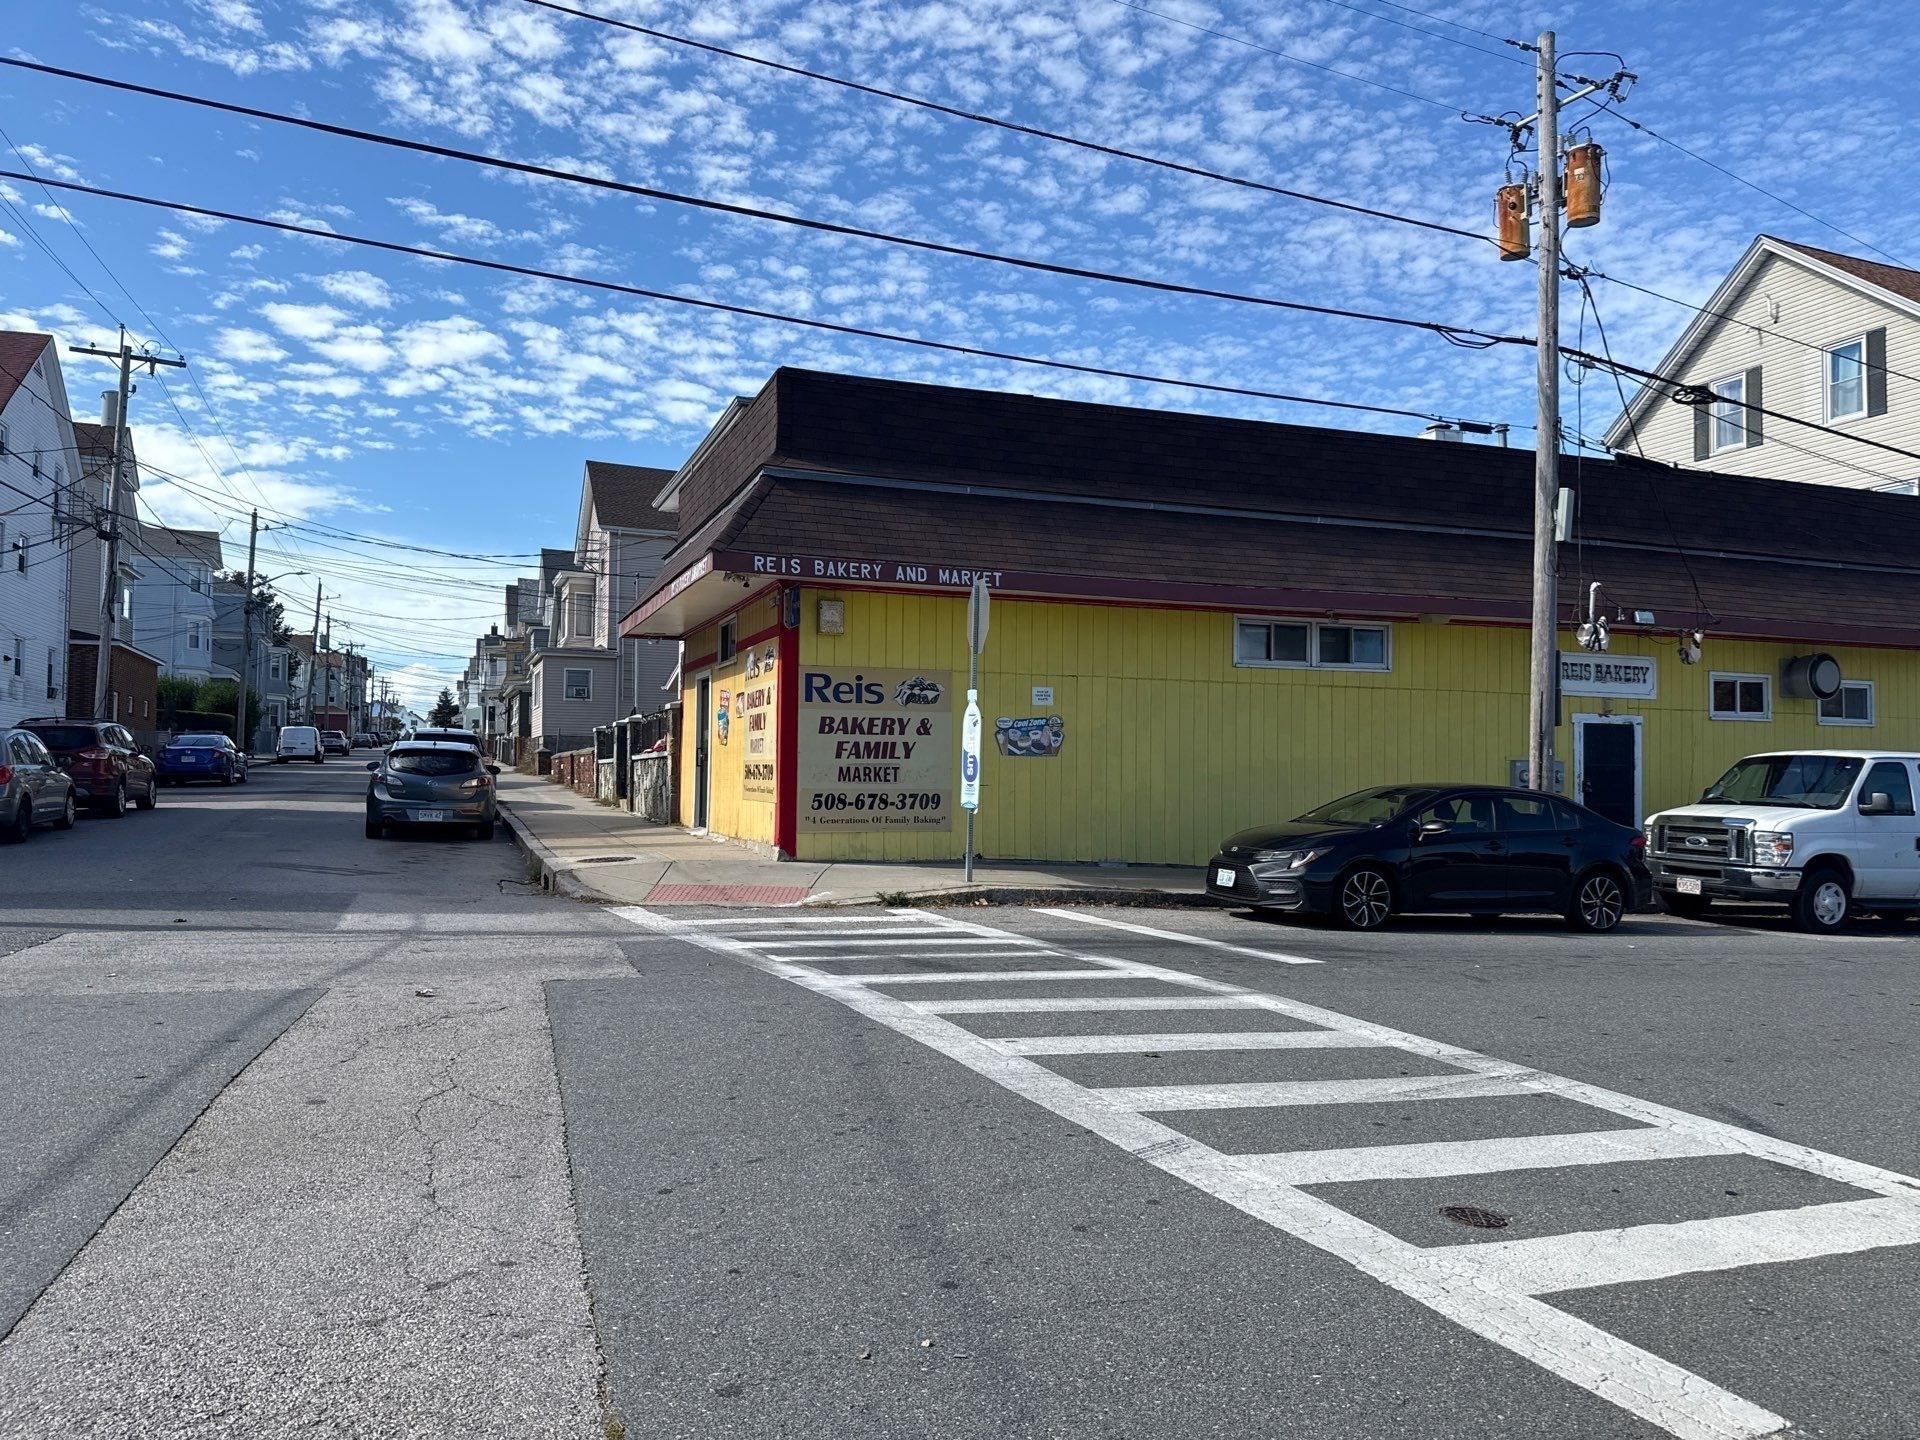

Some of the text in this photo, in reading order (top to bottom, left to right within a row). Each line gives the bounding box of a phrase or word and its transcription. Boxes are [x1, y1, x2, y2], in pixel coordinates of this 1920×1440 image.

[753, 555, 1002, 587] REIS BAKERY AND MARKET
[1561, 661, 1650, 684] REIS BAKERY
[804, 672, 885, 705] Reis
[818, 716, 933, 736] BAKERY &
[1013, 719, 1029, 728] Cool
[1029, 718, 1047, 727] Zone
[835, 741, 916, 760] FAMILY
[837, 766, 900, 783] MARKET
[811, 792, 942, 811] 508-678-3709
[819, 816, 870, 825] Generations
[872, 815, 883, 824] Of
[885, 815, 911, 826] Family
